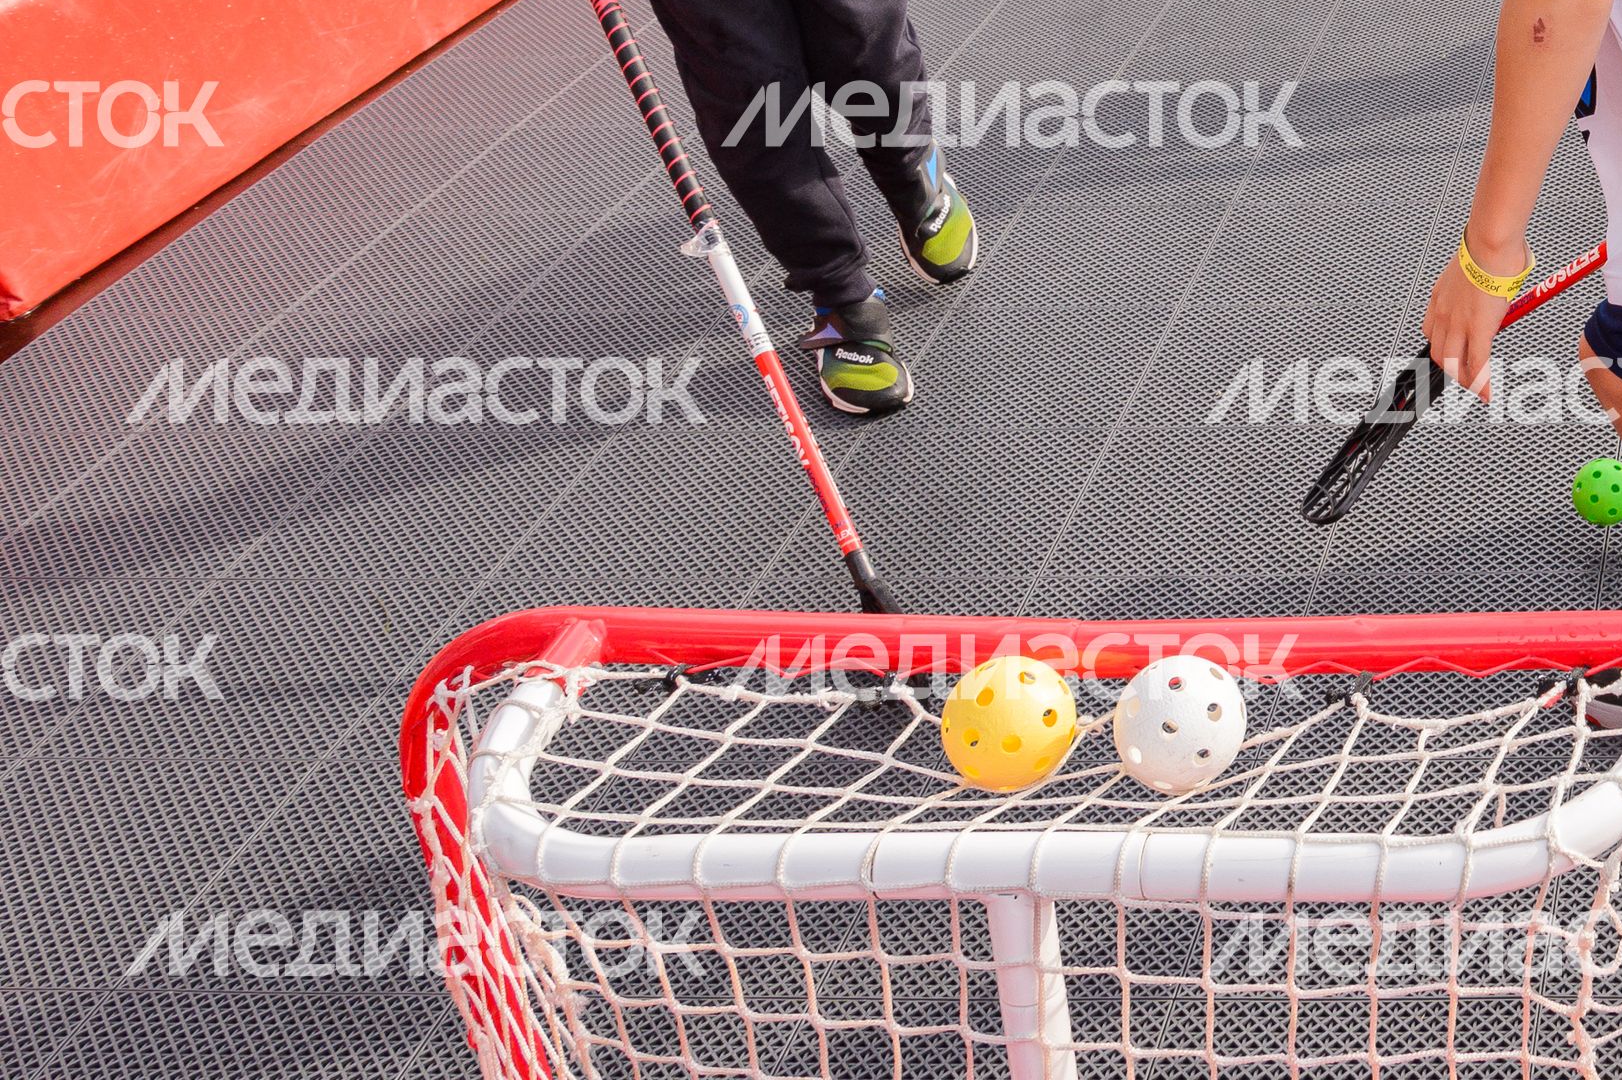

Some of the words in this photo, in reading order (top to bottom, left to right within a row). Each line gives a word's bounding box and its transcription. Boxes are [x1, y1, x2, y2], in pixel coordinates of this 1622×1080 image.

[929, 193, 951, 232] Reebok
[1535, 244, 1601, 298] FETISOV
[835, 347, 875, 365] Reebok
